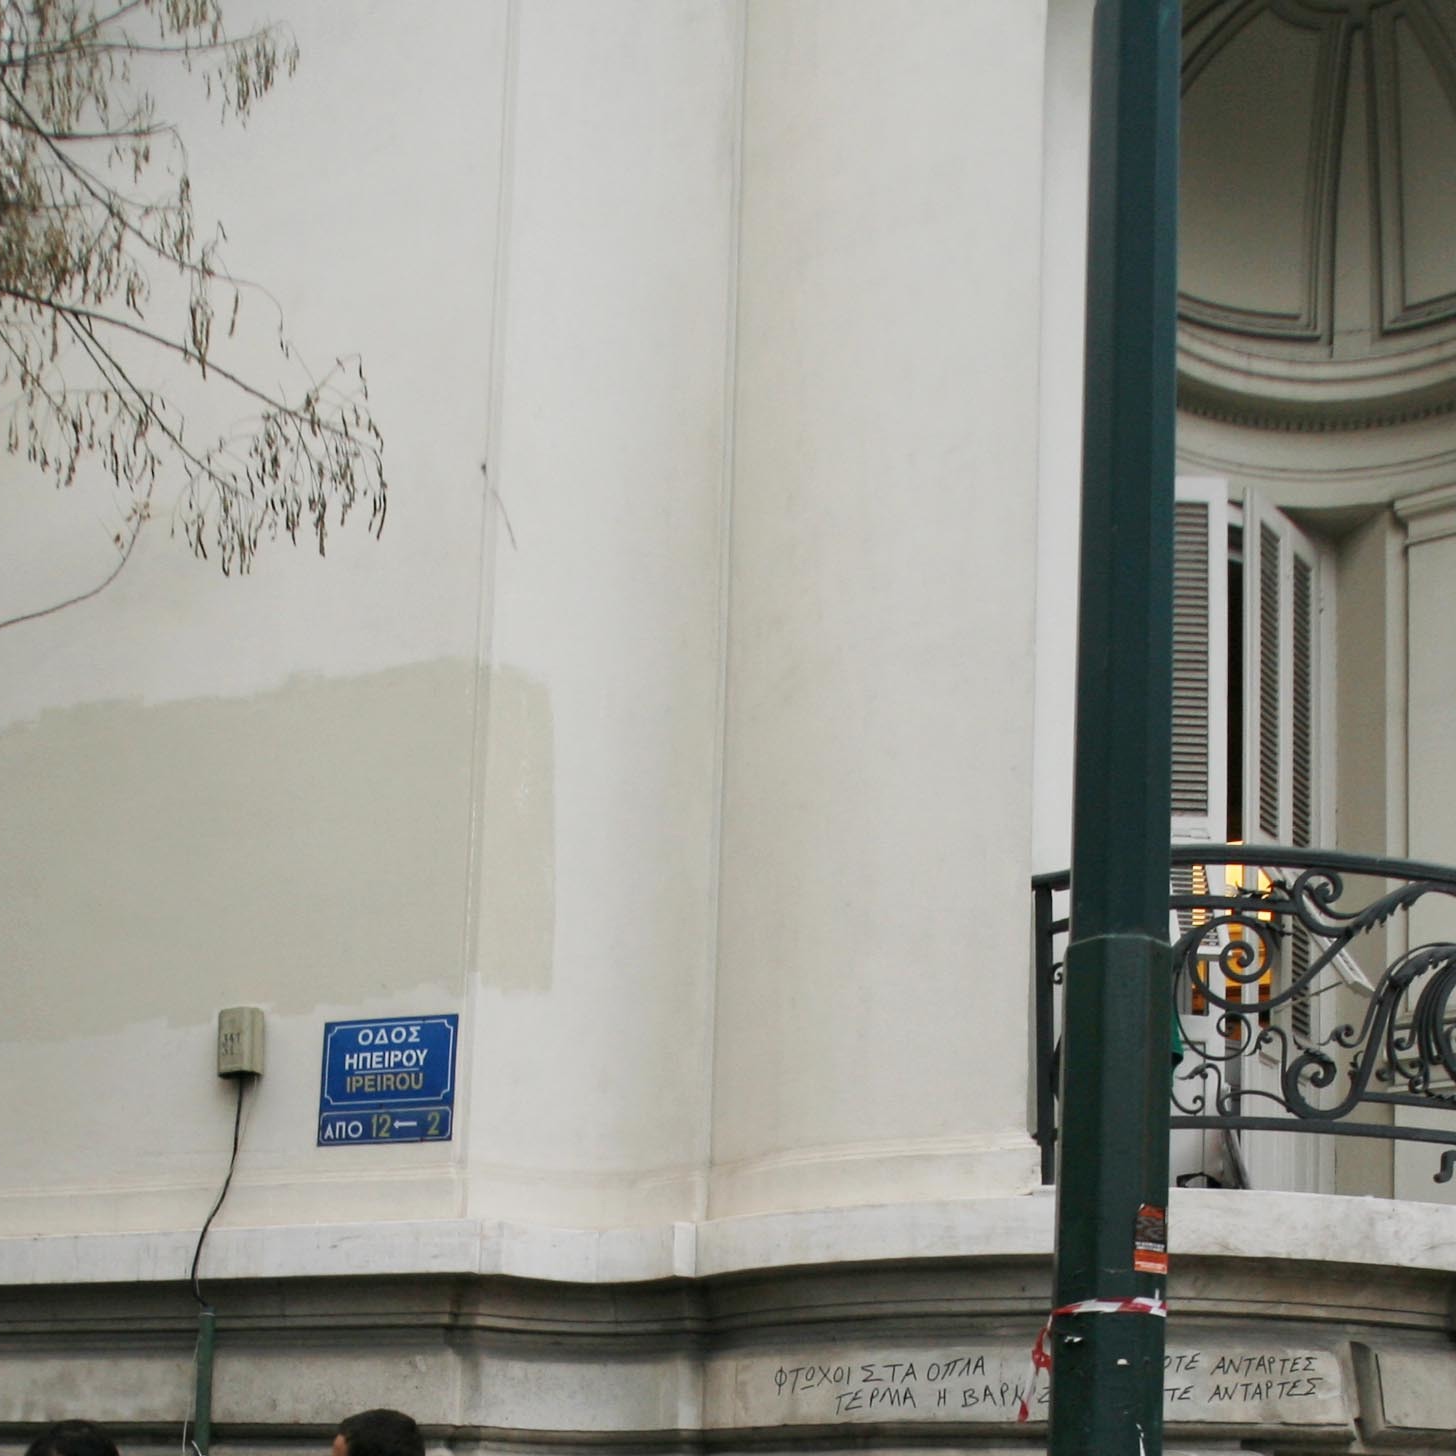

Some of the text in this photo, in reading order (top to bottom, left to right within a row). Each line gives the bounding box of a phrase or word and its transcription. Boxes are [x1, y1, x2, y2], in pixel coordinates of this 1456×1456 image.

[357, 1025, 422, 1046] ΟΔΟΣ
[344, 1048, 428, 1070] ΗΠΕΙΡΟΥ
[346, 1073, 424, 1093] IPEIROU
[323, 1112, 441, 1140] ΑΠΟ 12 2
[861, 1363, 917, 1384] ΣΤΑ
[927, 1355, 986, 1383] ΟΠΛΑ
[1164, 1352, 1201, 1373] ΟΤΕ
[1210, 1355, 1319, 1376] ΑΝΤΑΡΤΕΣ
[835, 1387, 917, 1415] ΤΕΡΜΑ
[937, 1387, 947, 1407] Η
[1164, 1385, 1194, 1403] ΤΕ
[1207, 1377, 1324, 1403] ΑΝΤΑΡΤΕΣ
